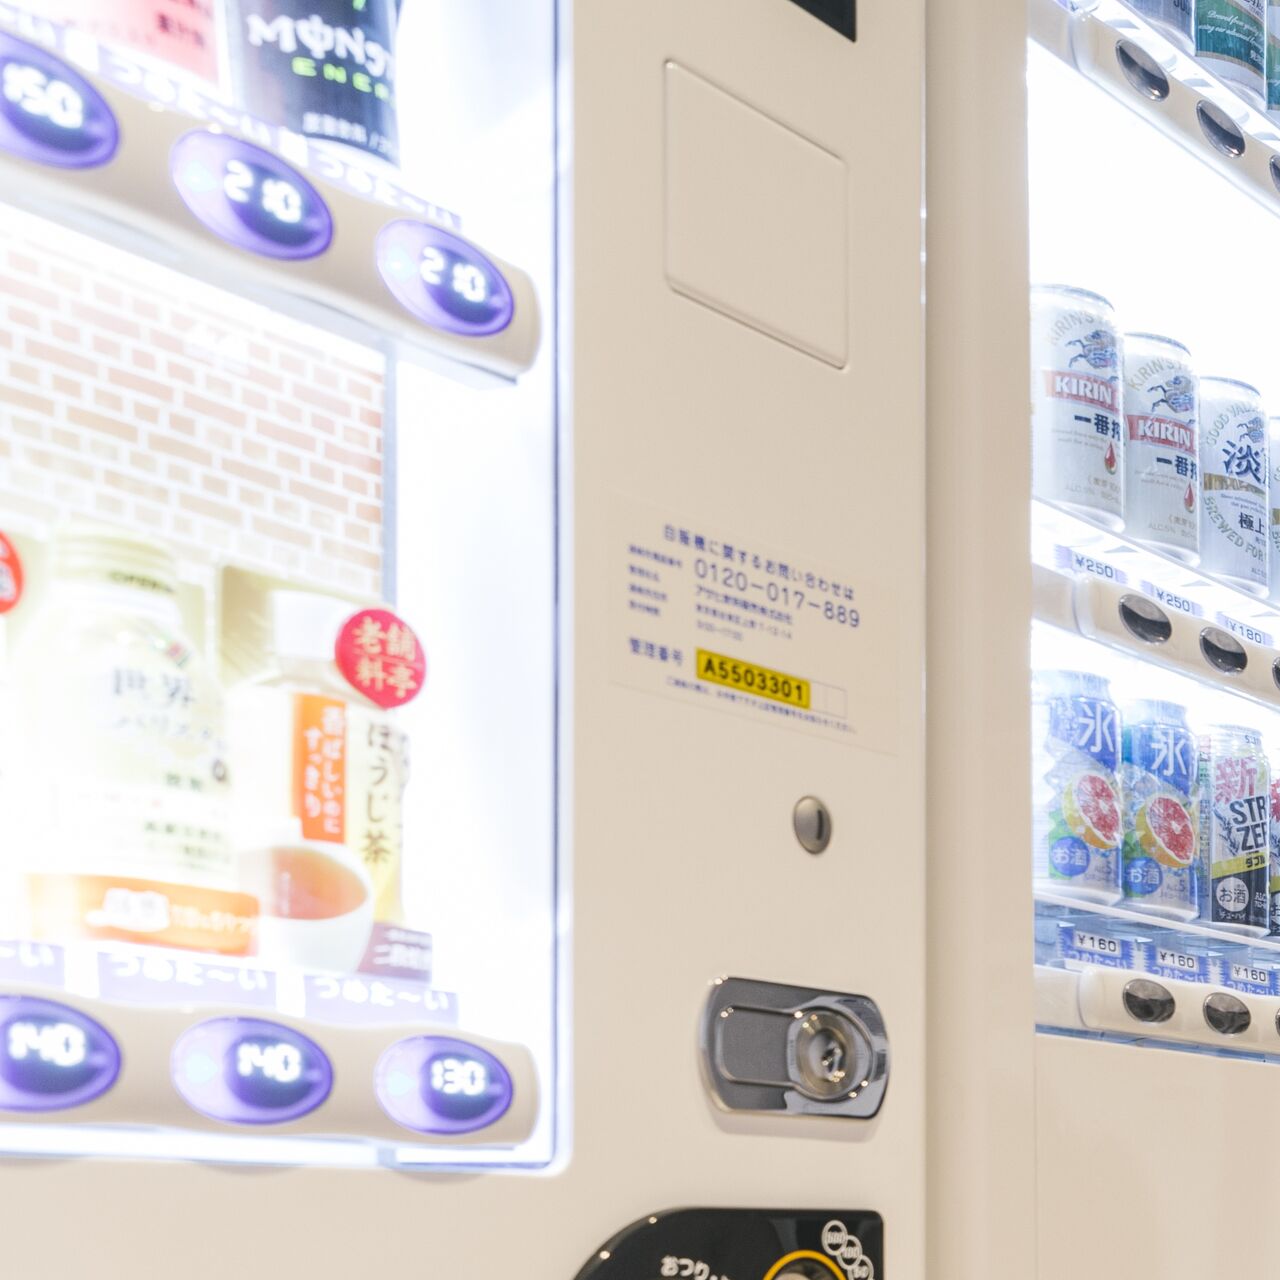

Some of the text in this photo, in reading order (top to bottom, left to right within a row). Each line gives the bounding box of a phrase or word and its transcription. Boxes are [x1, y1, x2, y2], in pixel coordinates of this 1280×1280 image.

[1055, 375, 1113, 405] KIRIN
[1138, 419, 1192, 448] KIRIN
[1074, 557, 1114, 580] ¥250
[695, 558, 859, 628] 0120-017-889
[1156, 589, 1191, 613] ¥250
[1230, 621, 1263, 645] ¥180
[703, 657, 804, 700] A5503301
[1151, 727, 1187, 776] 氷
[1215, 758, 1258, 803] 新
[1129, 867, 1161, 885] お酒
[1219, 886, 1247, 905] お酒
[1077, 932, 1117, 952] ¥160
[1159, 951, 1195, 970] ¥160
[1233, 965, 1267, 983] ¥160
[431, 1059, 486, 1096] 130
